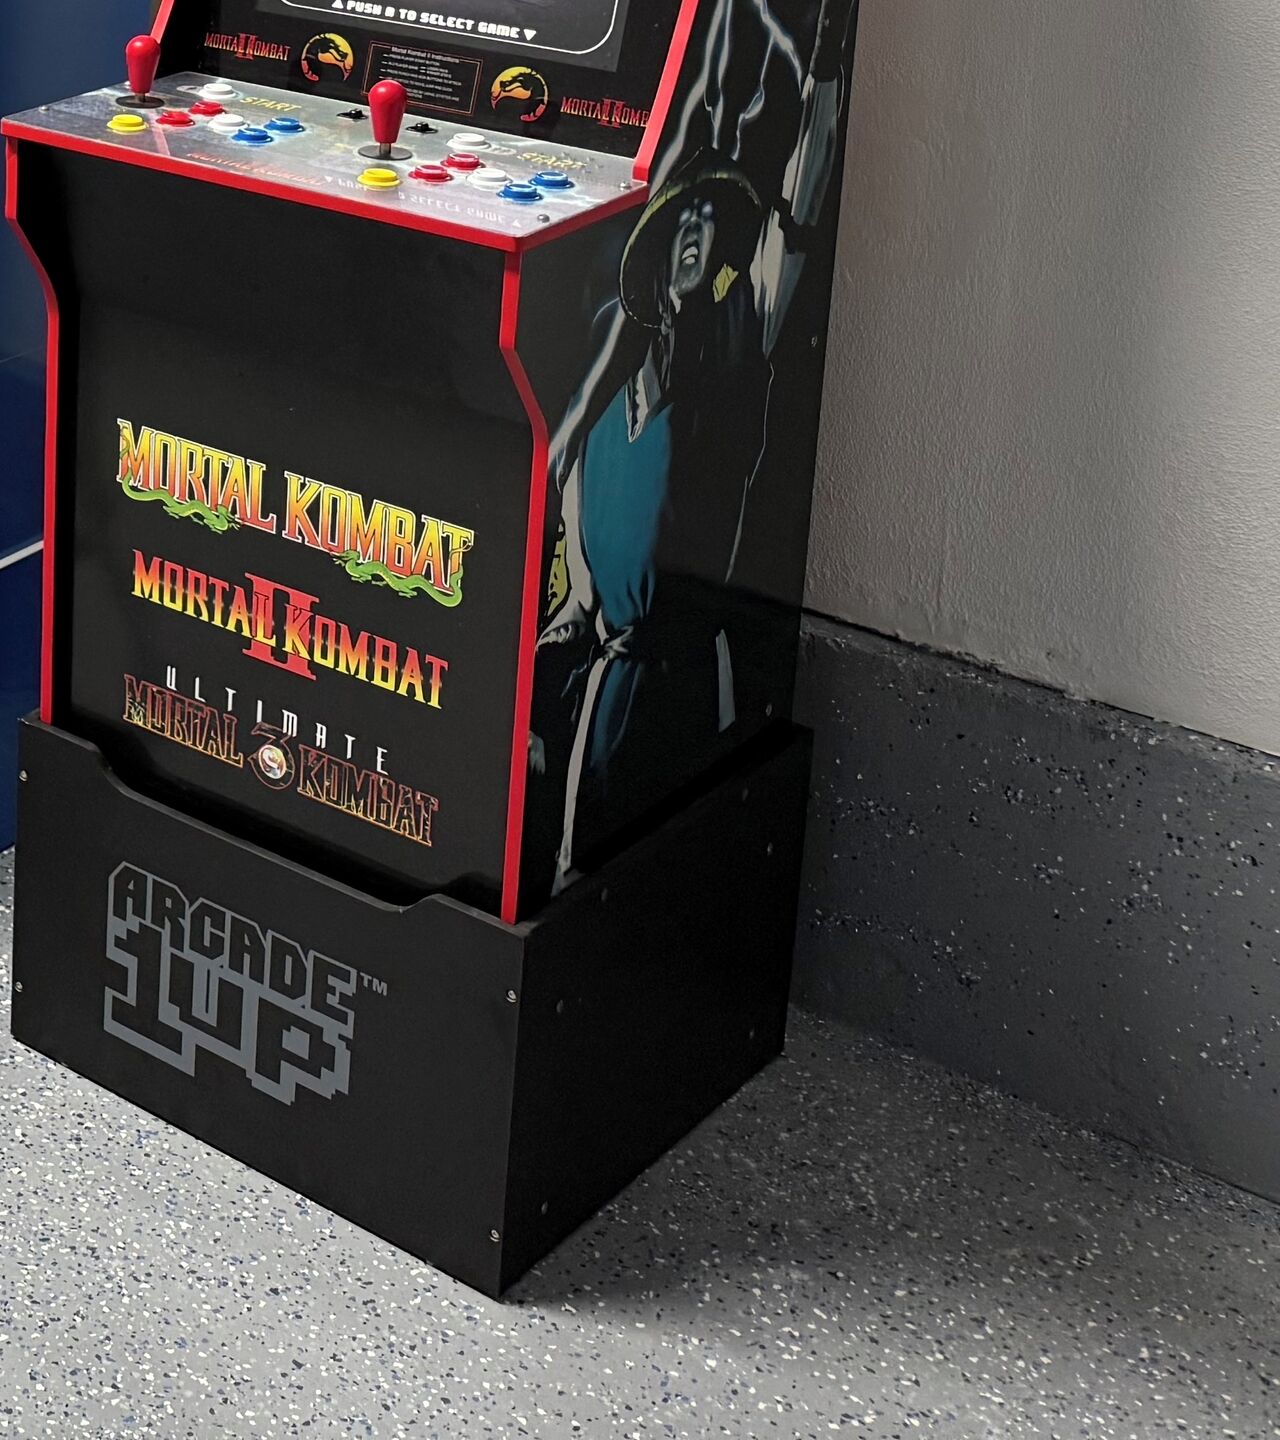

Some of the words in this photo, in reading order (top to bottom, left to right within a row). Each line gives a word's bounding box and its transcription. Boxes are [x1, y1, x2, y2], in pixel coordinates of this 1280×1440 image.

[204, 32, 244, 54] MORTAL
[246, 35, 292, 61] KOMBAT
[346, 0, 382, 16] PUSH
[399, 8, 416, 21] TO
[419, 11, 475, 31] SELECT
[477, 20, 521, 38] GAME
[240, 96, 303, 112] START
[560, 96, 609, 120] MORTAL
[611, 101, 650, 128] KOMB
[116, 418, 277, 534] MORTAL
[282, 470, 475, 596] KOMBAT
[131, 549, 278, 647] MORTAL
[281, 603, 449, 710] KOMBAT
[123, 673, 244, 768] MORTAL
[297, 742, 440, 848] KOMBAT
[166, 665, 390, 776] ULTIMATE
[104, 918, 352, 1106] 1UP
[108, 861, 358, 1030] ARCADE
